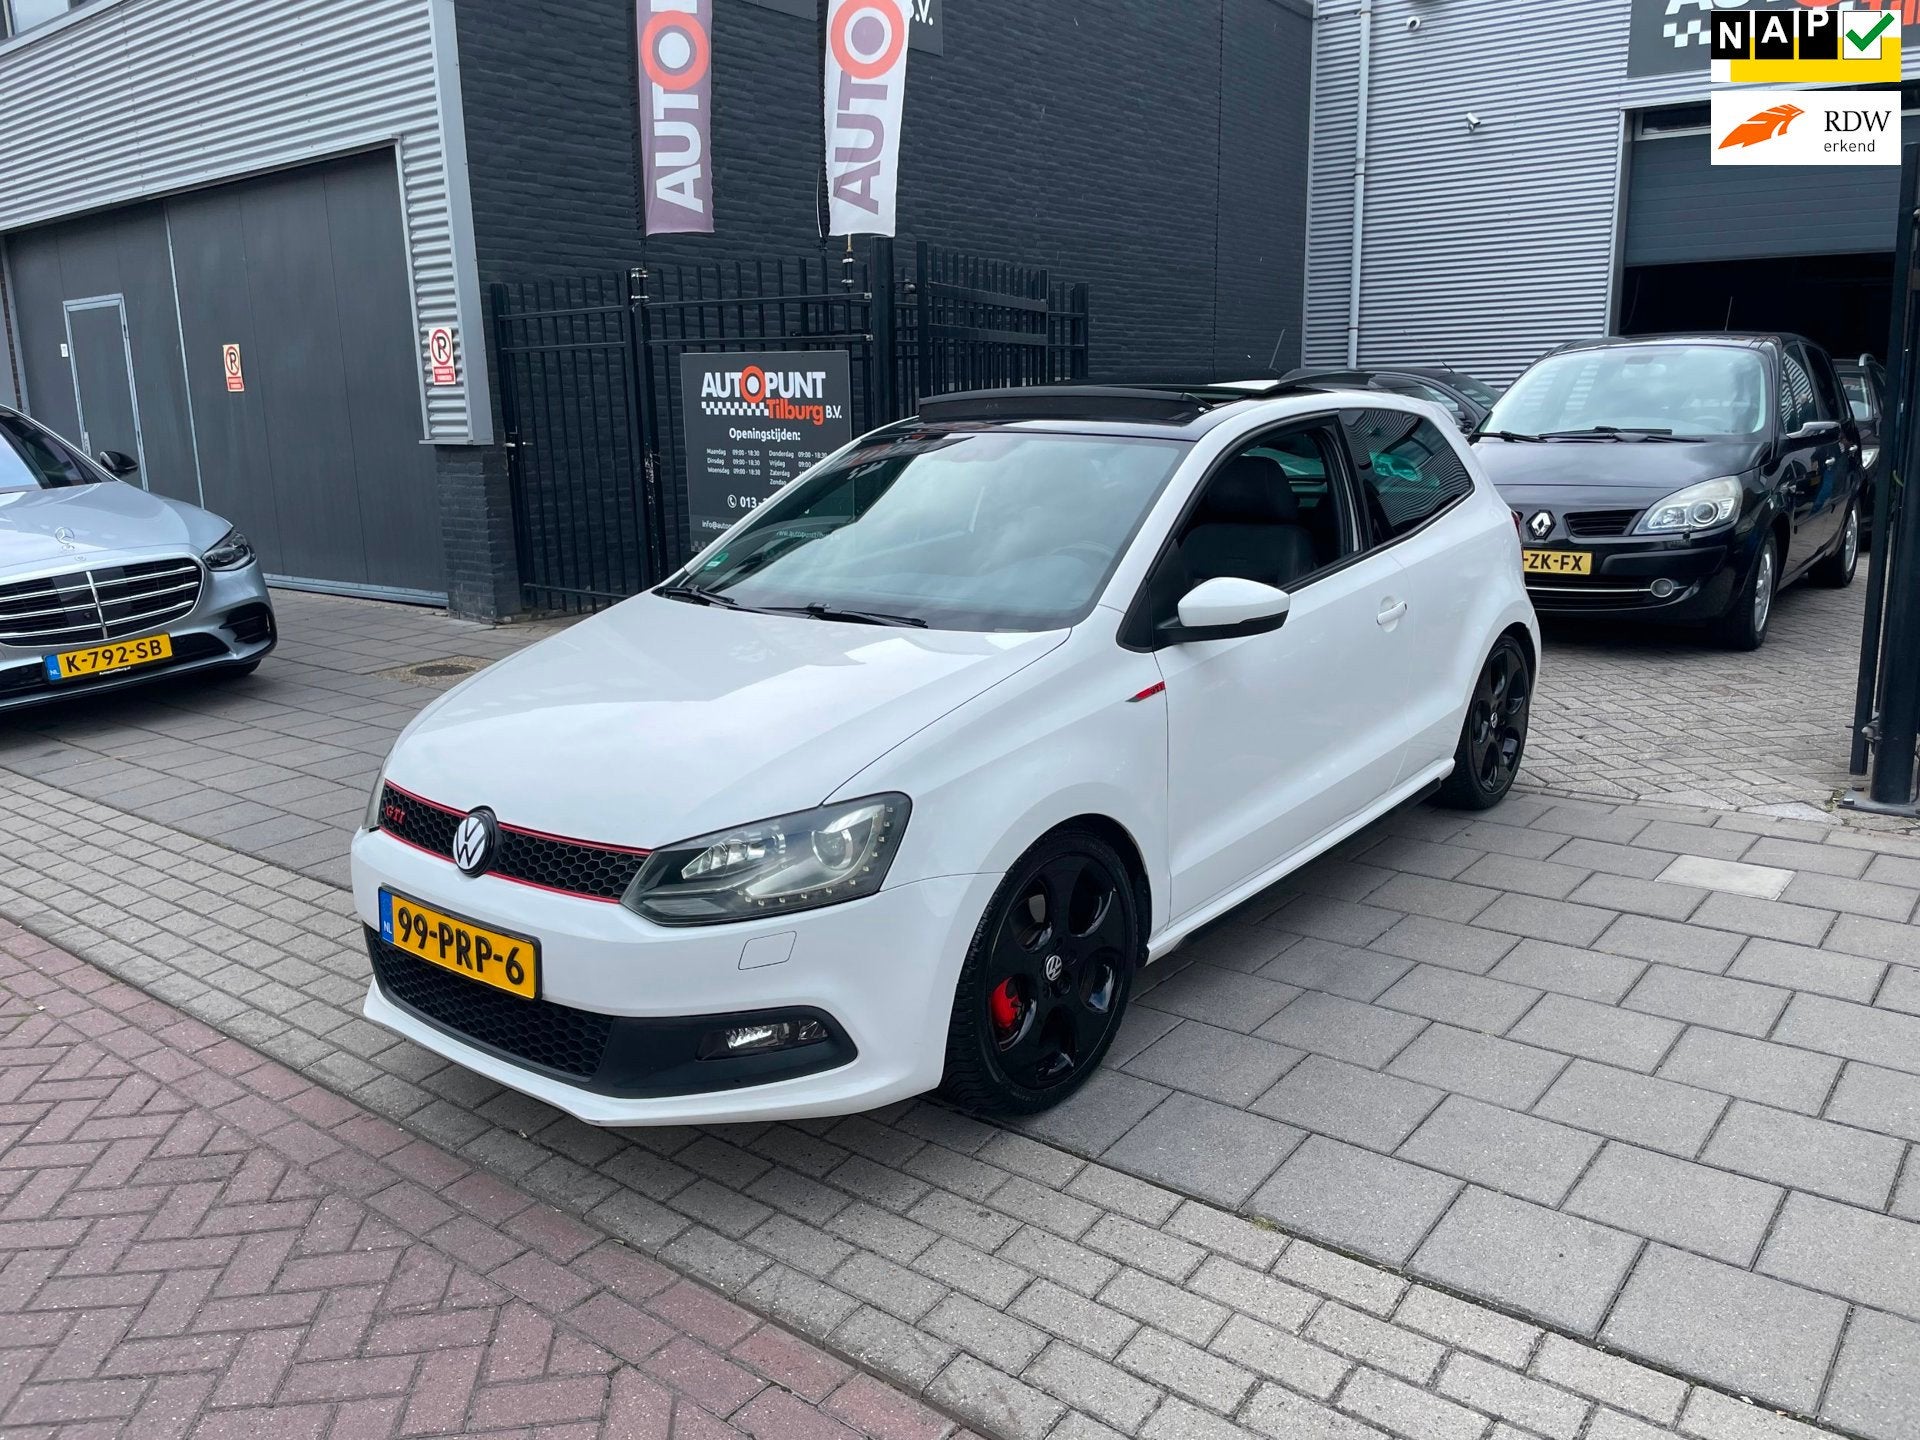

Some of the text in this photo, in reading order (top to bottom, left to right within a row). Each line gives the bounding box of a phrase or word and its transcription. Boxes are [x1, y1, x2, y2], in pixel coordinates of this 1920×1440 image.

[641, 0, 709, 214] AUTO
[701, 365, 826, 404] AUTOPUNT
[766, 399, 842, 425] Tilburg B.V.
[729, 427, 801, 442] Openingstijden:
[707, 448, 727, 456] Maandag
[769, 450, 794, 458] Donderdag
[769, 459, 786, 468] Vrijdag
[769, 469, 790, 478] Zaterdag
[65, 639, 162, 673] K-792-SB
[385, 805, 406, 825] GTI
[383, 906, 525, 986] NL 99-PRP-6
